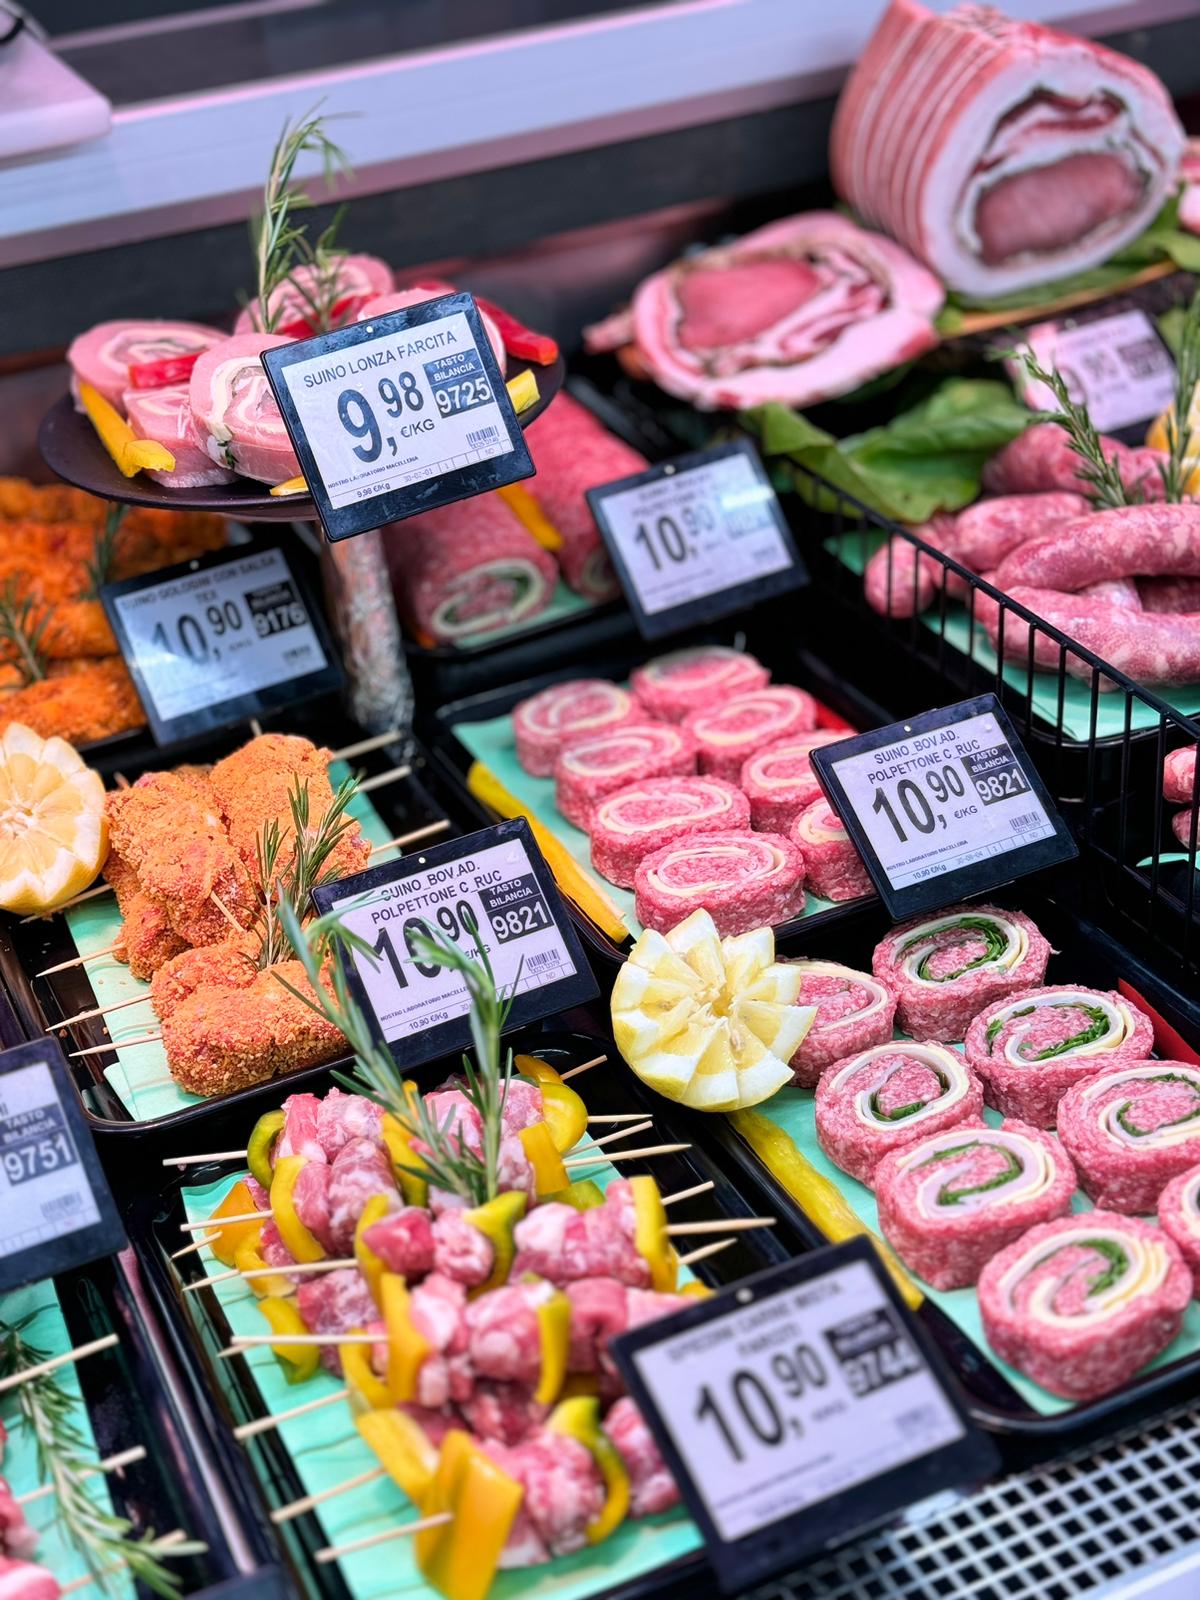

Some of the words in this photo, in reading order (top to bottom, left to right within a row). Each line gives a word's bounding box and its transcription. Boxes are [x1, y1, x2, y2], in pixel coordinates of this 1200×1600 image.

[304, 364, 346, 388] SUINO
[350, 350, 396, 374] LONZA
[396, 330, 458, 359] FARCITA
[434, 354, 464, 369] TASTO
[434, 362, 476, 382] BILANCIA
[436, 377, 490, 414] 9725
[400, 418, 435, 438] €/KG
[254, 602, 306, 636] 9176
[868, 752, 942, 784] POLPETTONE
[942, 740, 980, 759] C_RUC
[970, 748, 998, 762] TASTO
[972, 756, 1010, 772] BILANCIA
[976, 768, 1026, 801] 9821
[954, 805, 978, 819] €/KG
[371, 886, 457, 924] POLPETTONE
[459, 870, 502, 894] C_RUC
[490, 879, 522, 894] TASTO
[490, 887, 532, 908] BILANCIA
[492, 901, 548, 939] 9821
[409, 1017, 430, 1030] 10,90
[5, 1110, 44, 1129] TASTO
[2, 1117, 57, 1144] BILANCIA
[4, 1132, 72, 1182] 9751
